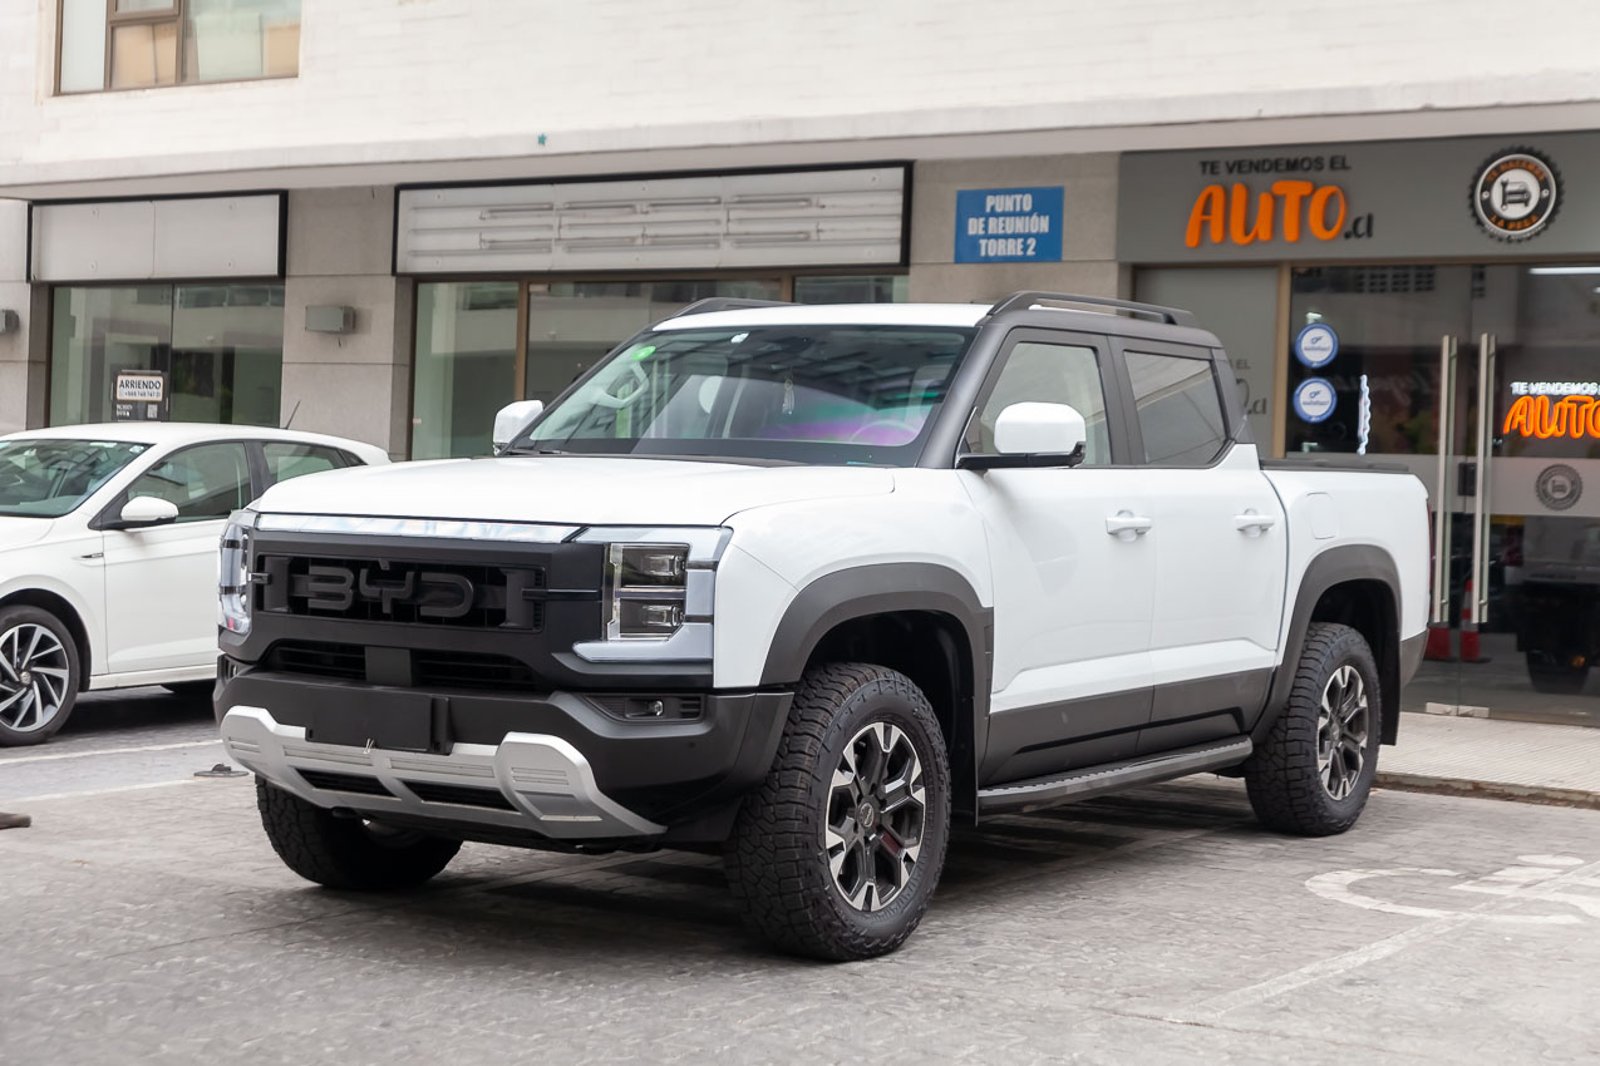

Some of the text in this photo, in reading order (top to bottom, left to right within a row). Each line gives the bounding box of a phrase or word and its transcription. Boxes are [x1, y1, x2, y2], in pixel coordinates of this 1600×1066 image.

[1200, 155, 1351, 175] TE VENDEMOS EL
[985, 193, 1032, 213] PUNTO
[967, 212, 1050, 236] DE REUNIÓN
[979, 237, 1037, 257] TORRE 2
[119, 379, 162, 390] ARRIENDO
[1511, 382, 1598, 396] TE VENDEMOS
[308, 557, 474, 618] BYD
